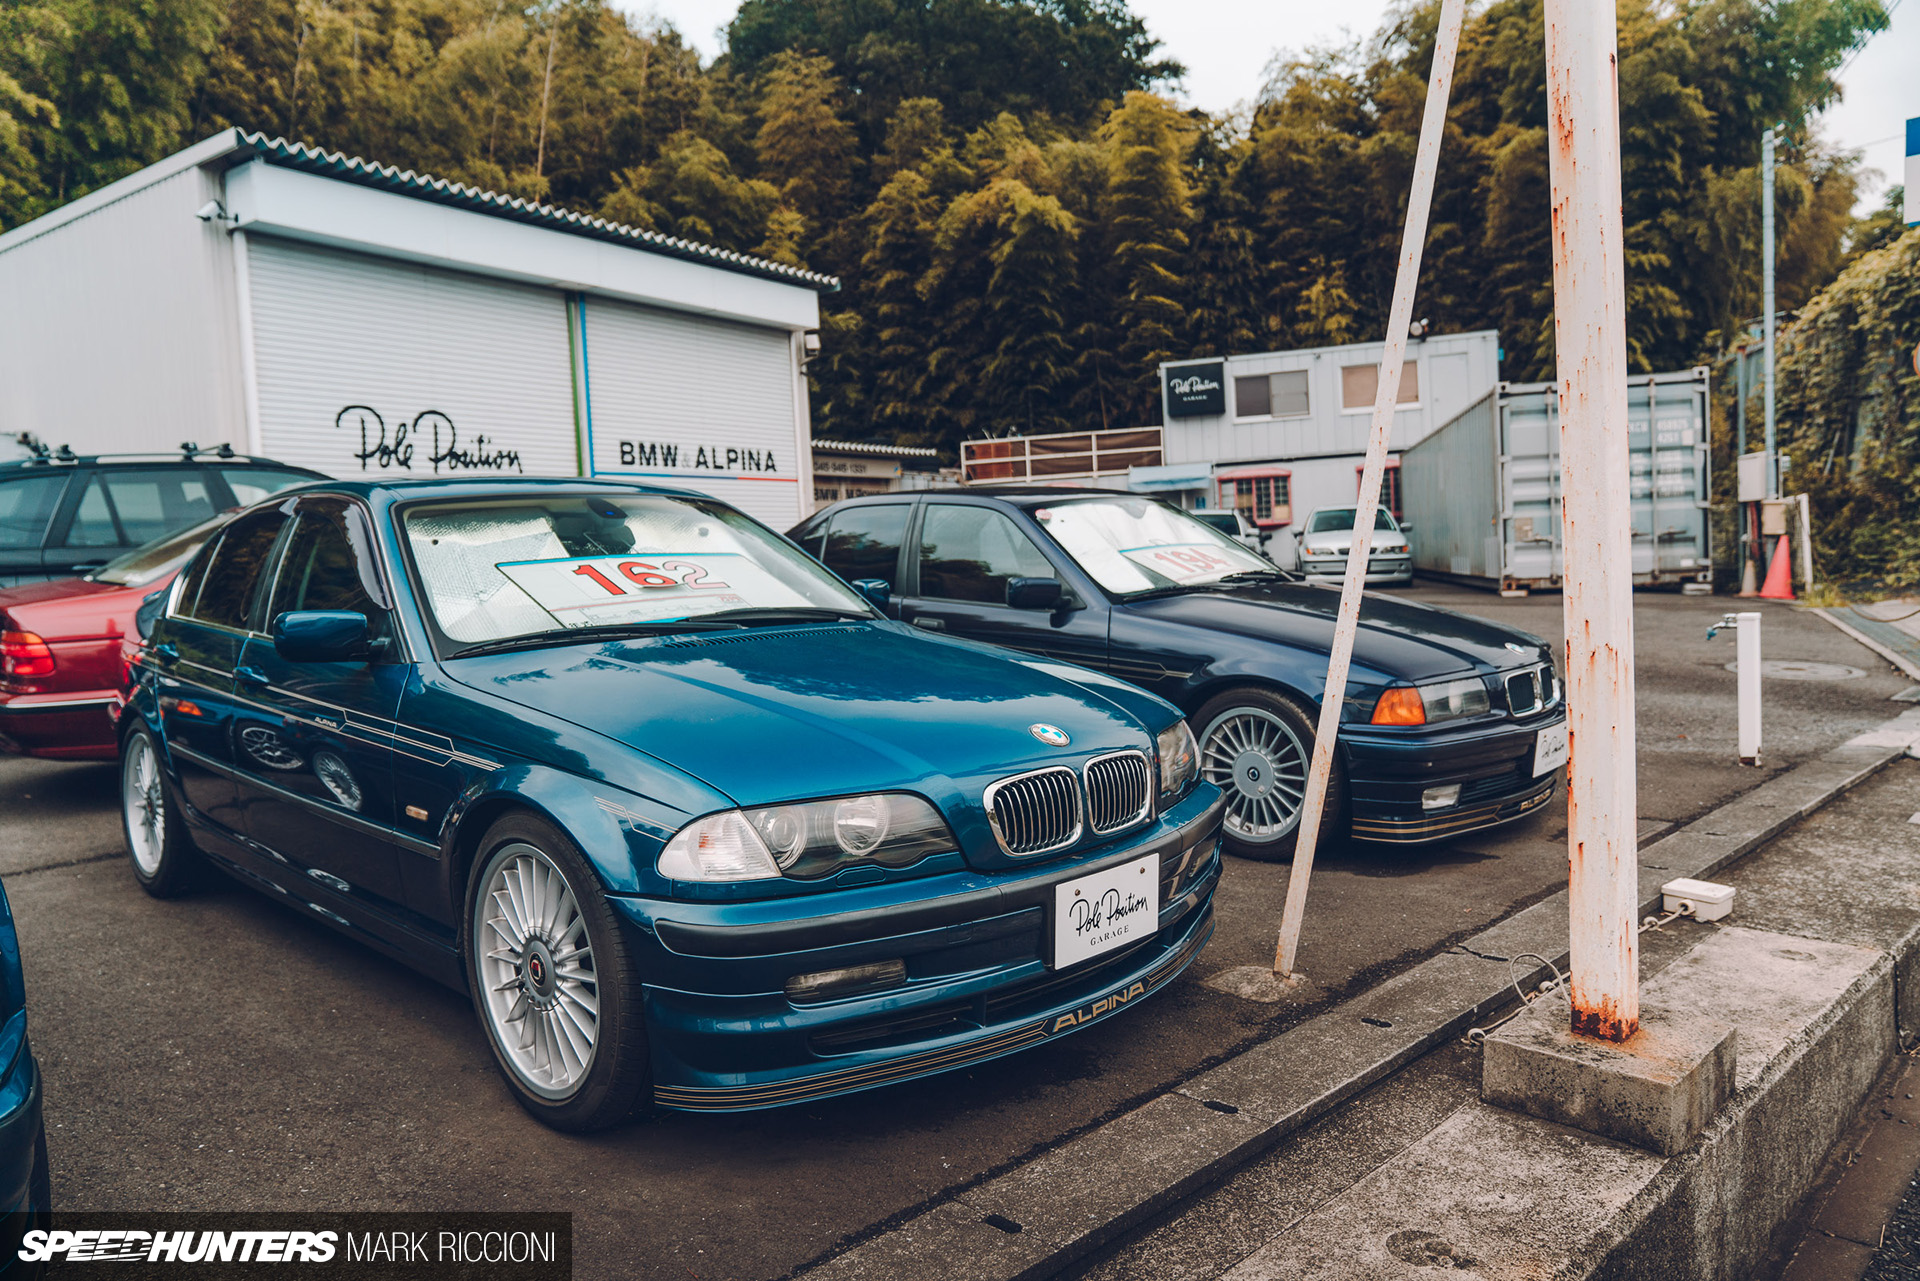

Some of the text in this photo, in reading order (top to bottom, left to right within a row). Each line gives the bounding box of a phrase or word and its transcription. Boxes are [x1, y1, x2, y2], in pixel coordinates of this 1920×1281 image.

[336, 405, 523, 475] Pole Position
[620, 441, 678, 467] BMW
[695, 445, 777, 472] ALPINA
[1154, 548, 1231, 573] 194
[572, 560, 731, 595] 162
[314, 716, 337, 728] ALPINA
[1069, 888, 1148, 937] Pole Position
[1090, 924, 1130, 946] GARAGE
[1052, 981, 1145, 1033] ALPINA
